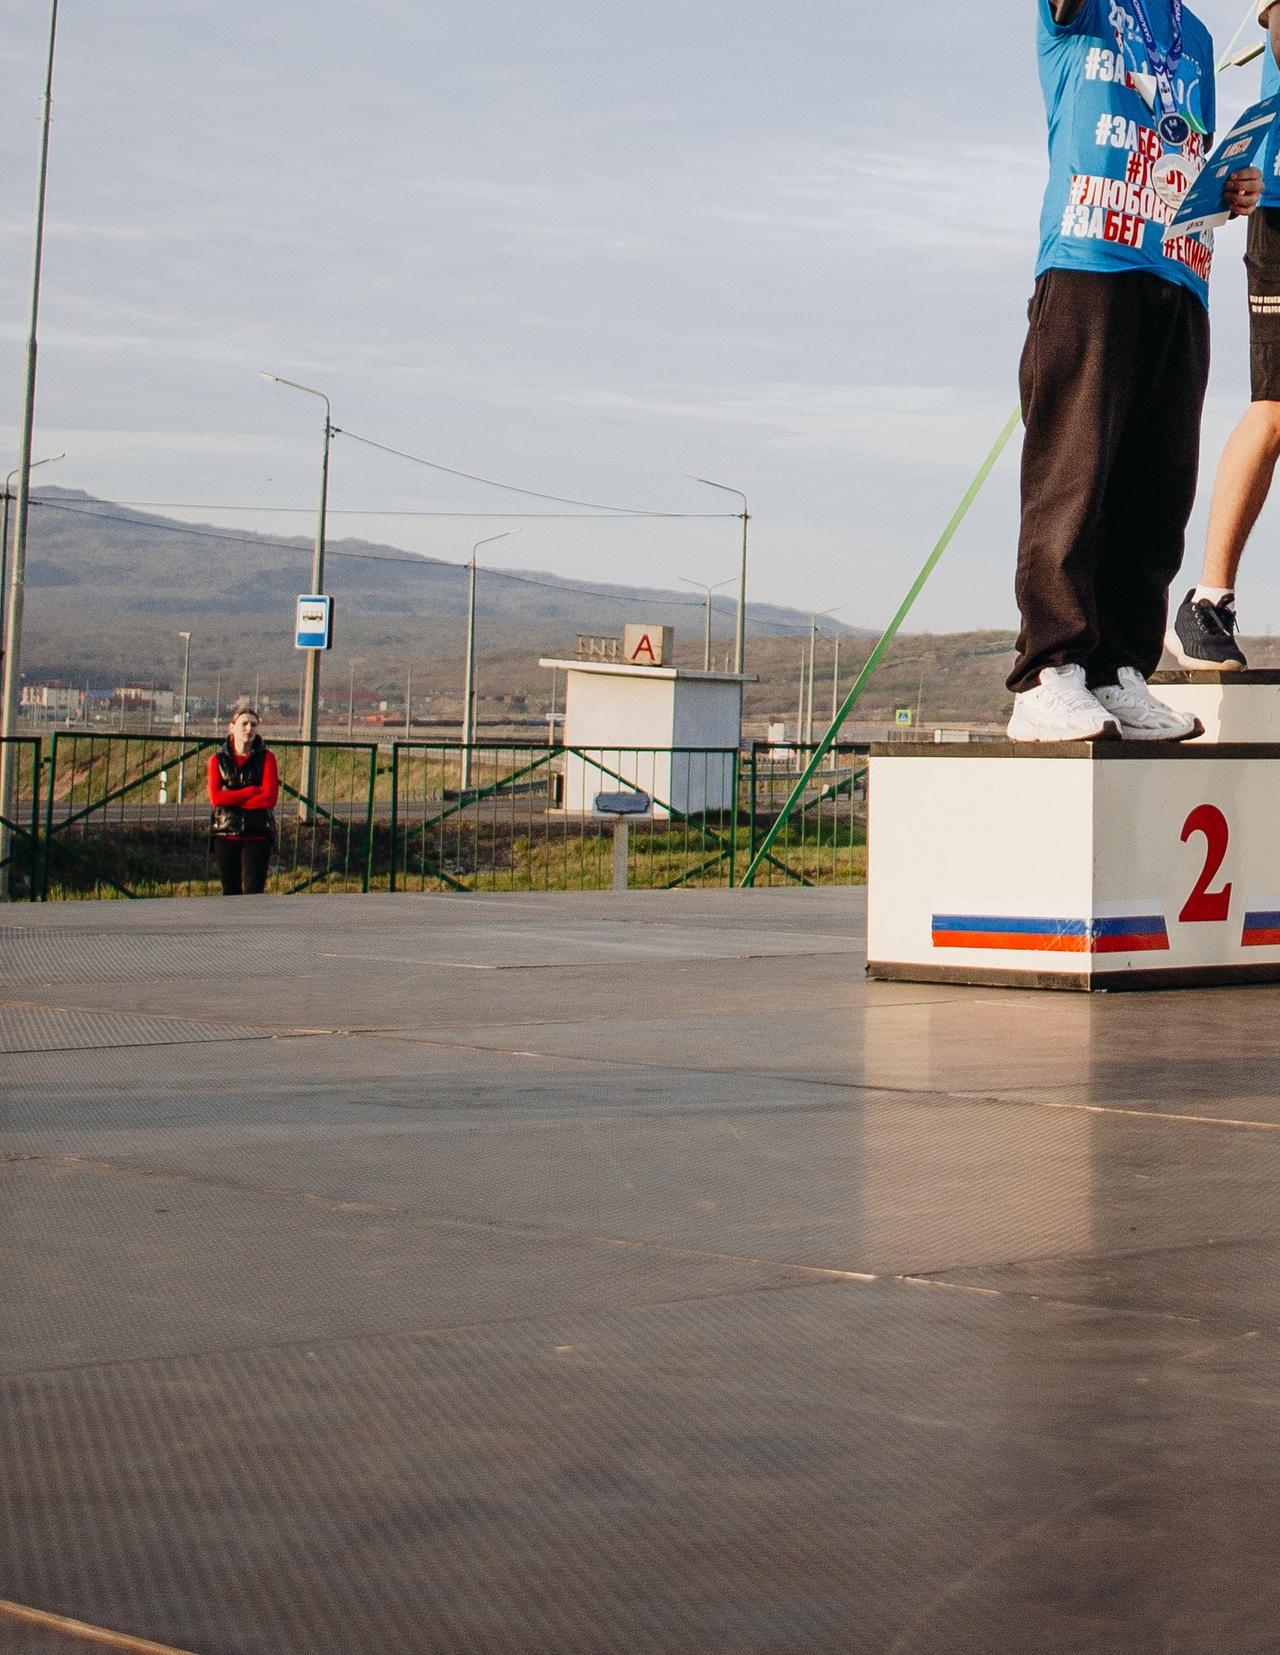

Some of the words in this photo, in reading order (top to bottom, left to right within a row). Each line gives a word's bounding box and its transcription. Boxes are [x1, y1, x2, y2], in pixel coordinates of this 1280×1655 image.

[1061, 205, 1145, 249] #ЗАБЕГ
[631, 634, 655, 661] А
[1178, 804, 1232, 922] 2
